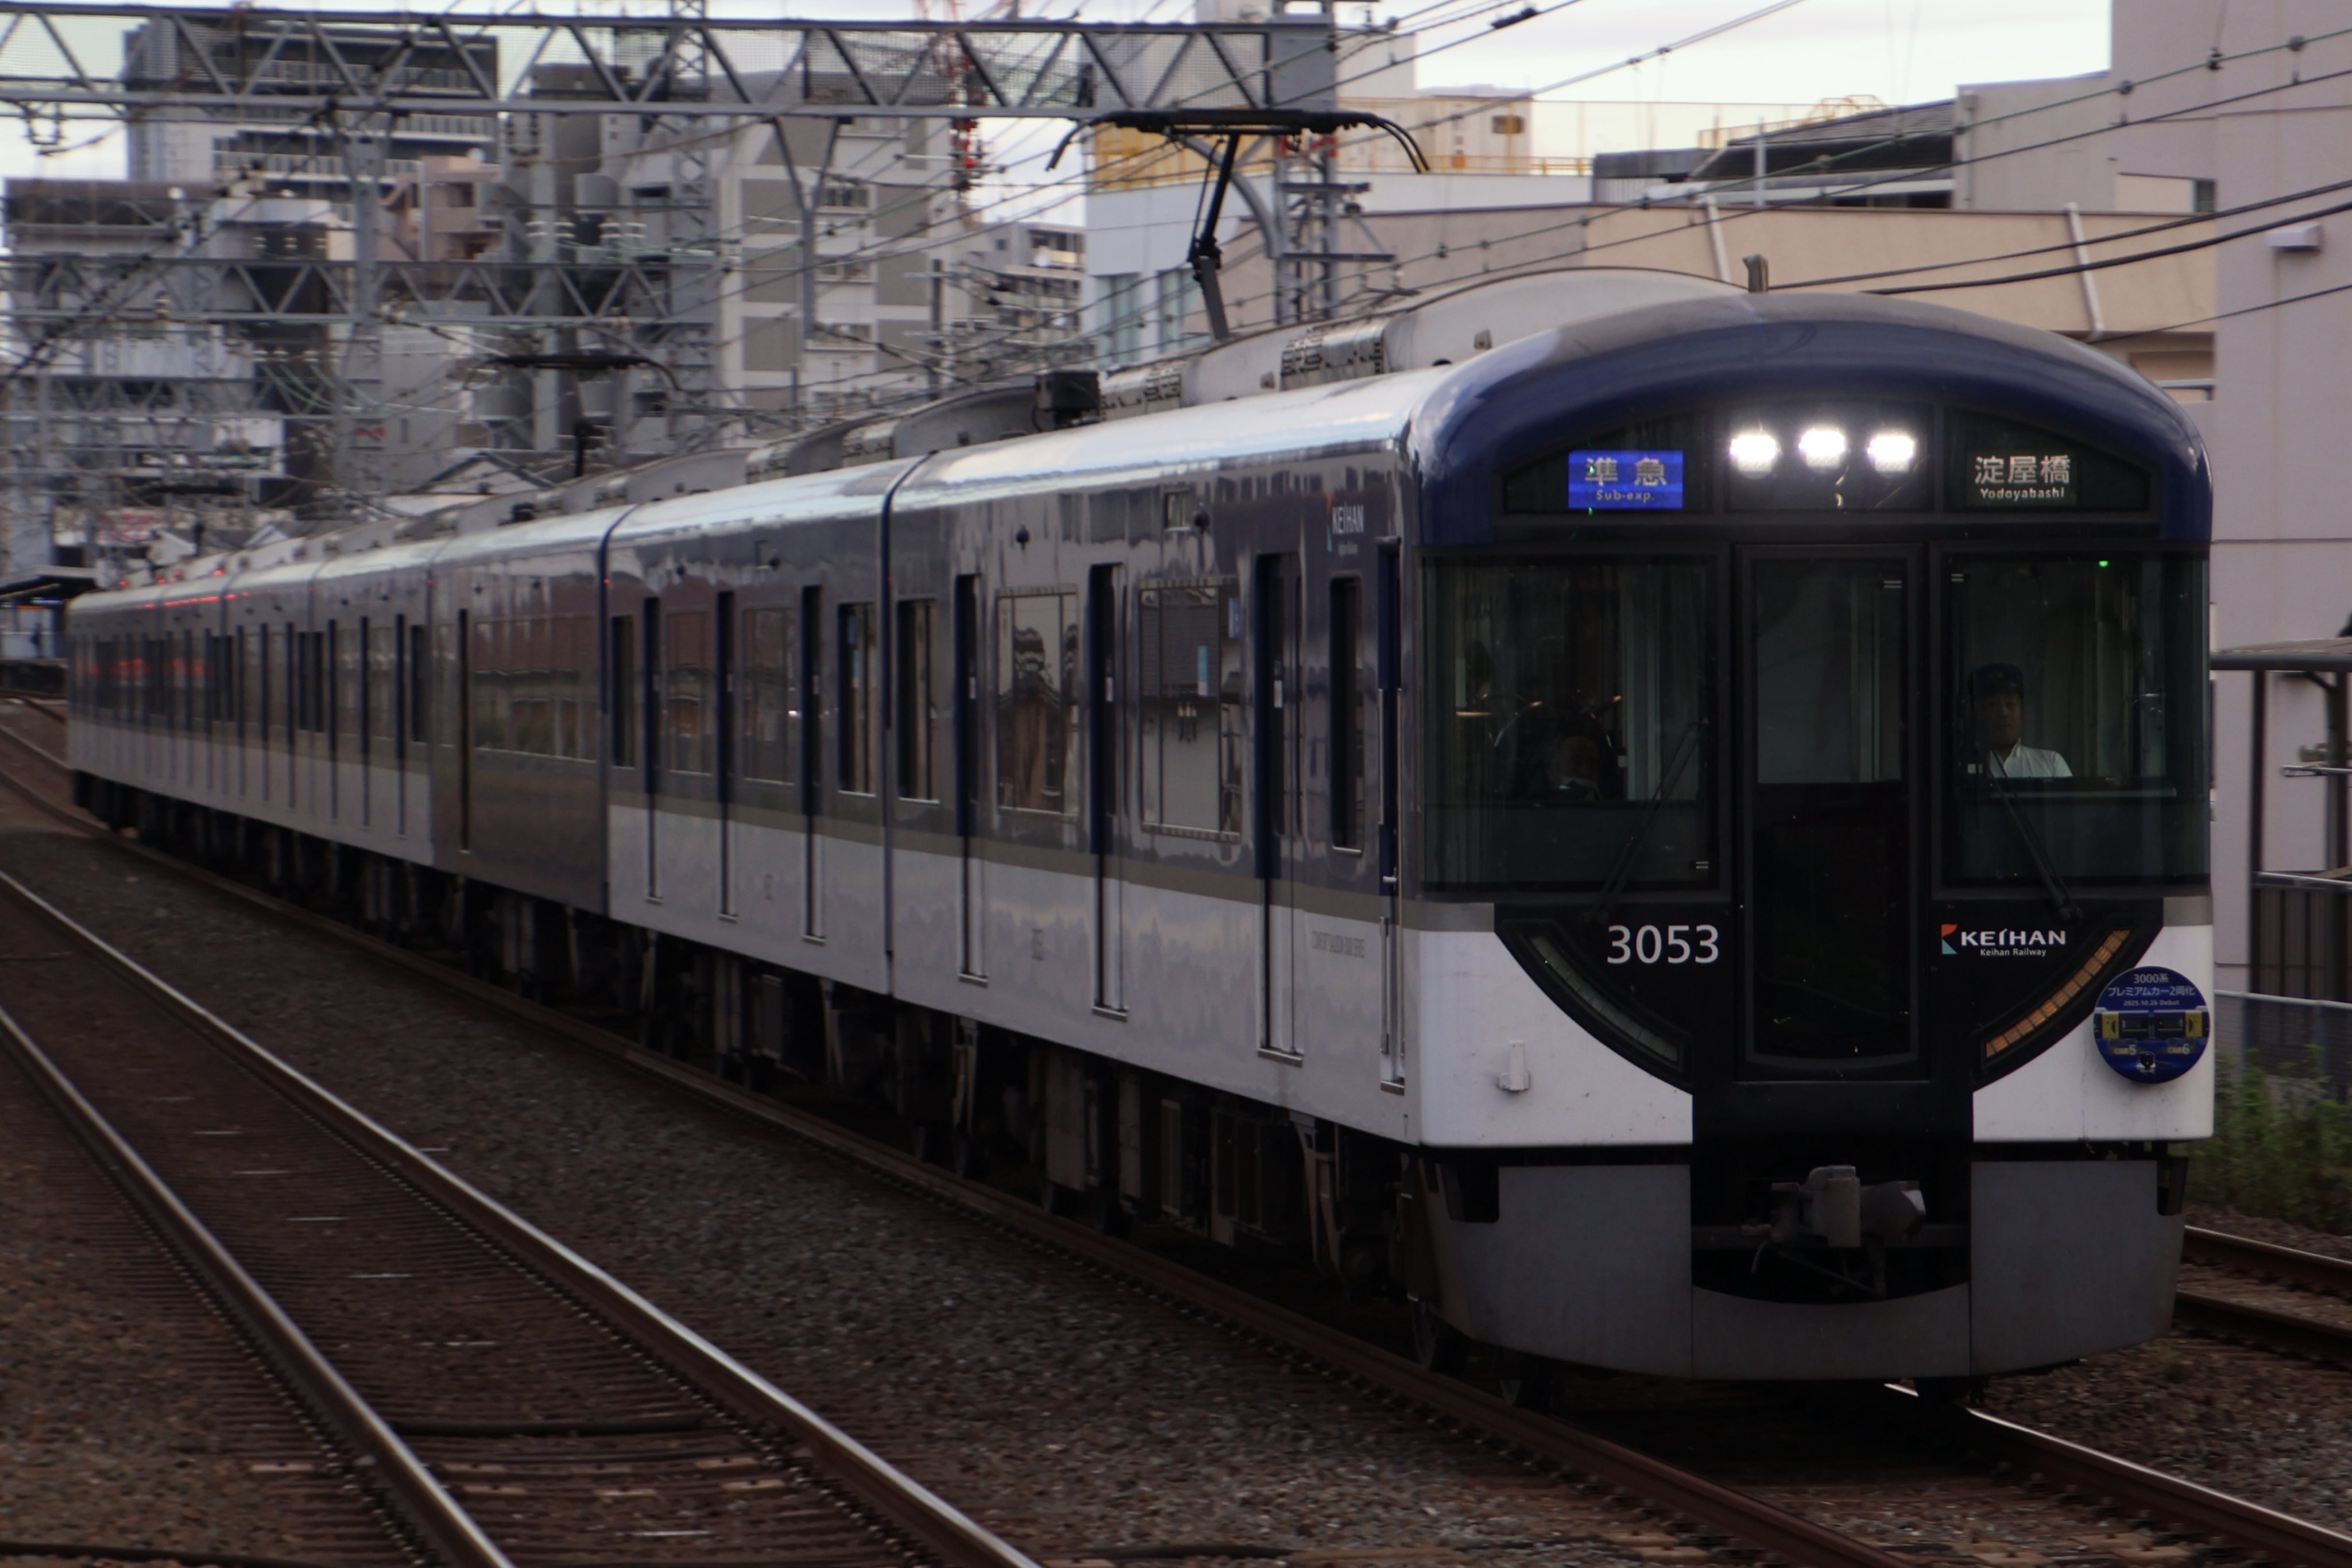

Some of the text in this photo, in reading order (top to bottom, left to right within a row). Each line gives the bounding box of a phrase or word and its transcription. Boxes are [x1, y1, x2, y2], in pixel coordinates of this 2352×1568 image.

[1585, 457, 1666, 486] 準急
[1975, 455, 2070, 484] 淀屋橋
[1596, 490, 1654, 502] Sub-exp.
[1980, 487, 2064, 501] Yodoyabashi
[1332, 502, 1364, 534] KEIHAN
[1607, 924, 1719, 964] 3053
[1961, 928, 2065, 946] KEIHAN
[2013, 948, 2047, 957] Railway
[2133, 973, 2168, 984] 3000系
[2108, 986, 2196, 997] プレミアムカー2両化
